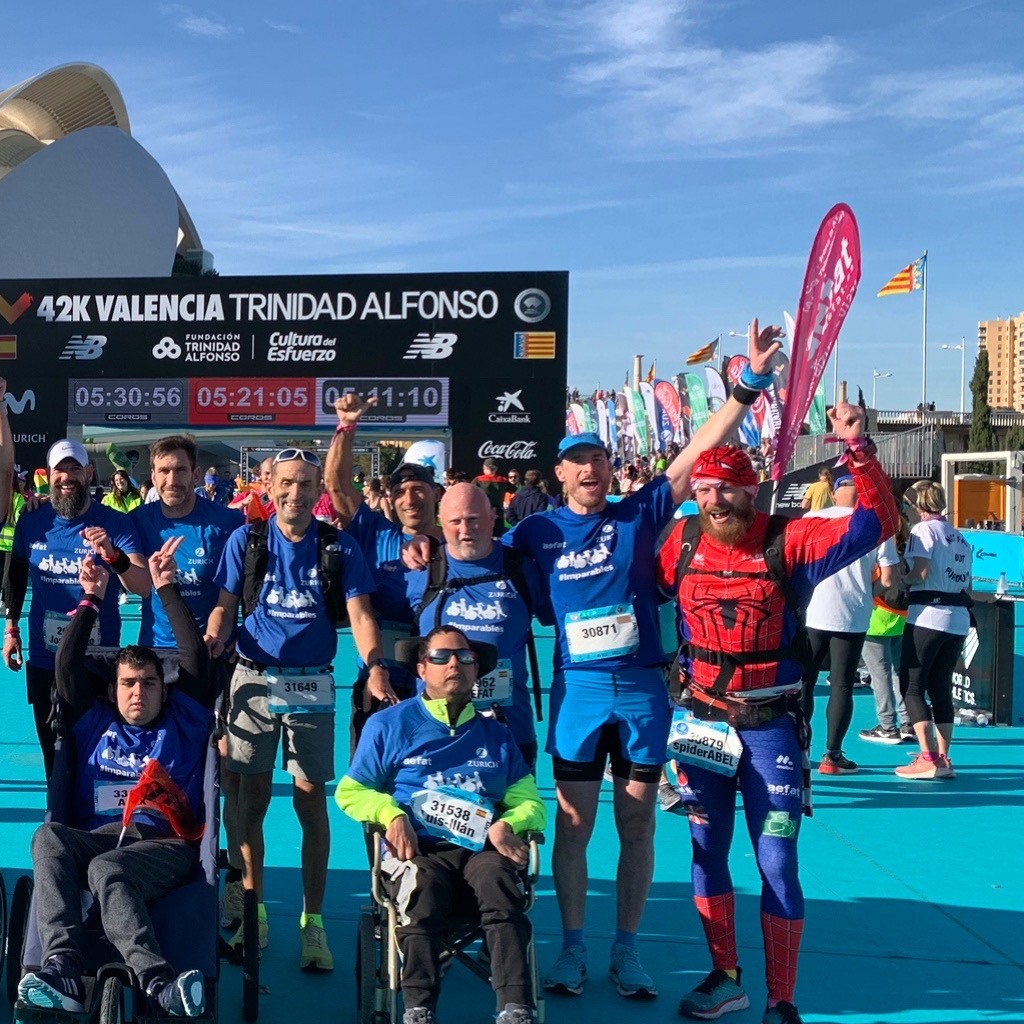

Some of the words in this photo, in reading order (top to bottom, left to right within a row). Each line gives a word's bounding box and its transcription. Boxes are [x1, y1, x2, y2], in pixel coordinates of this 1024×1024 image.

[37, 294, 91, 322] 42K
[95, 293, 224, 322] VALENCIA
[229, 291, 357, 321] TRINIDAD
[360, 289, 499, 320] ALFONSO
[185, 332, 240, 341] FUNDACIÓN
[269, 331, 323, 347] Cultura
[323, 337, 336, 347] del
[185, 341, 240, 352] TRINIDAD
[185, 352, 240, 362] ALFONSO
[267, 346, 336, 362] Esfuerzo
[76, 386, 180, 407] 05:30:56
[197, 386, 308, 407] 05:21:05
[488, 413, 531, 423] CaixaBank
[13, 432, 46, 444] URICH
[188, 557, 214, 565] ZURICH
[581, 622, 618, 640] 30871
[284, 682, 318, 693] 31649
[471, 688, 494, 699] EFAT
[672, 740, 735, 768] spiderABEL
[467, 760, 499, 769] ZURICH
[430, 799, 471, 822] 31538
[422, 810, 476, 838] uis-Illán
